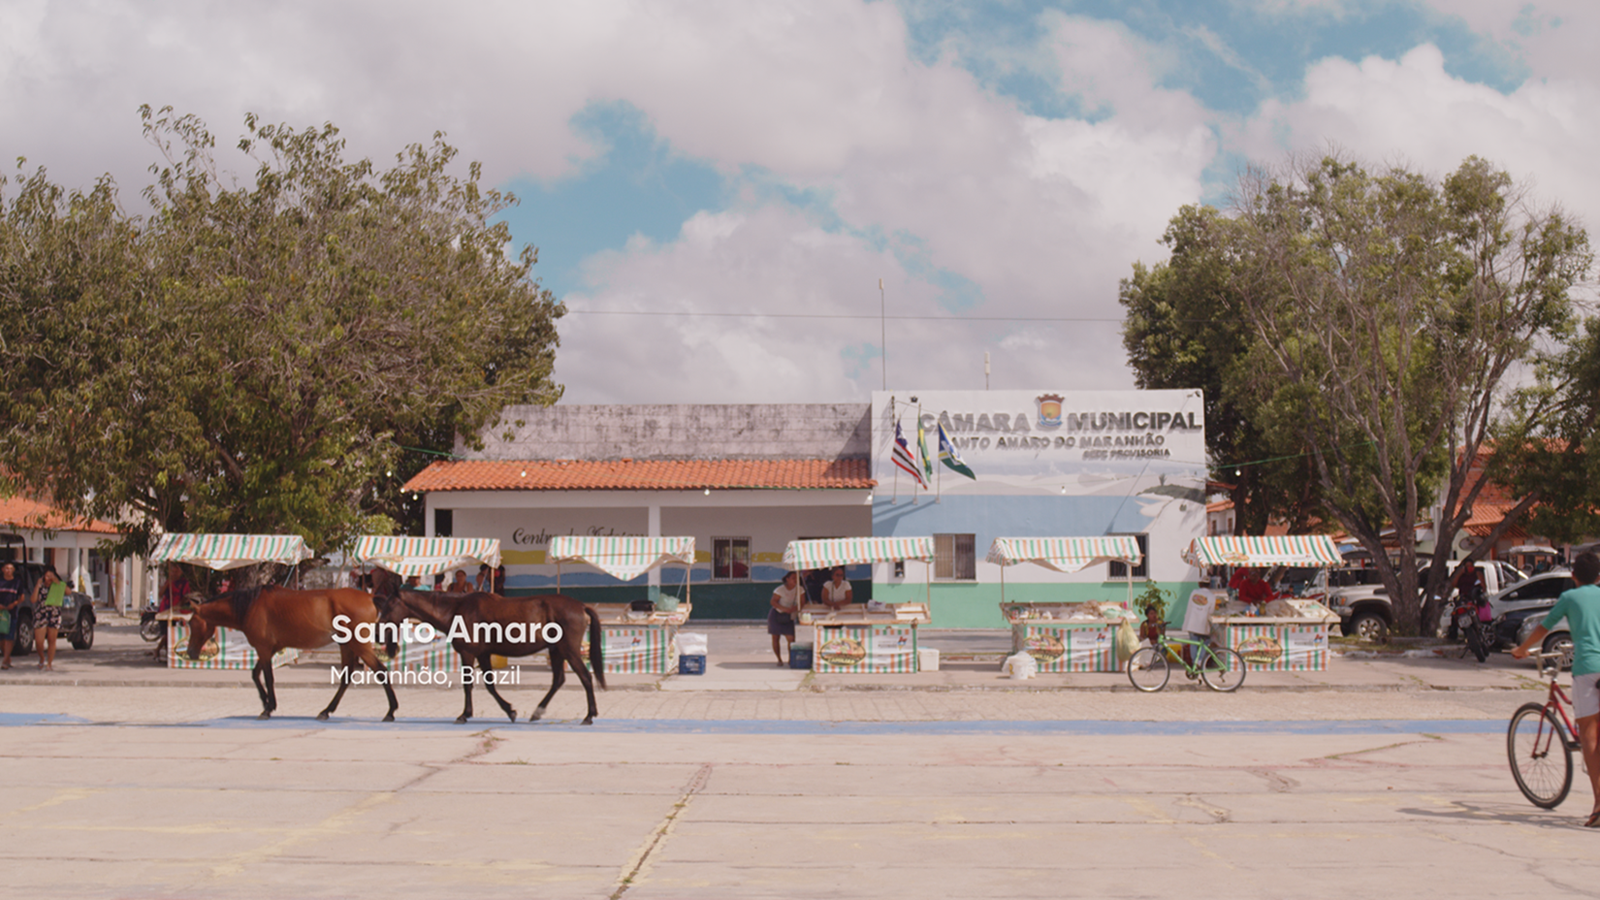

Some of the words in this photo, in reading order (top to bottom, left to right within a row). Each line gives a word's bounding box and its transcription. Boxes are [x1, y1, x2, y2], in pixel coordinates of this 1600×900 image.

[919, 410, 1032, 434] CÂMARA
[1067, 411, 1203, 433] MUNICIPAL
[951, 437, 990, 450] ANTO
[996, 436, 1052, 450] AMARO
[1054, 436, 1076, 449] DO
[1079, 432, 1166, 448] MARANHÃO
[512, 527, 557, 545] Centr
